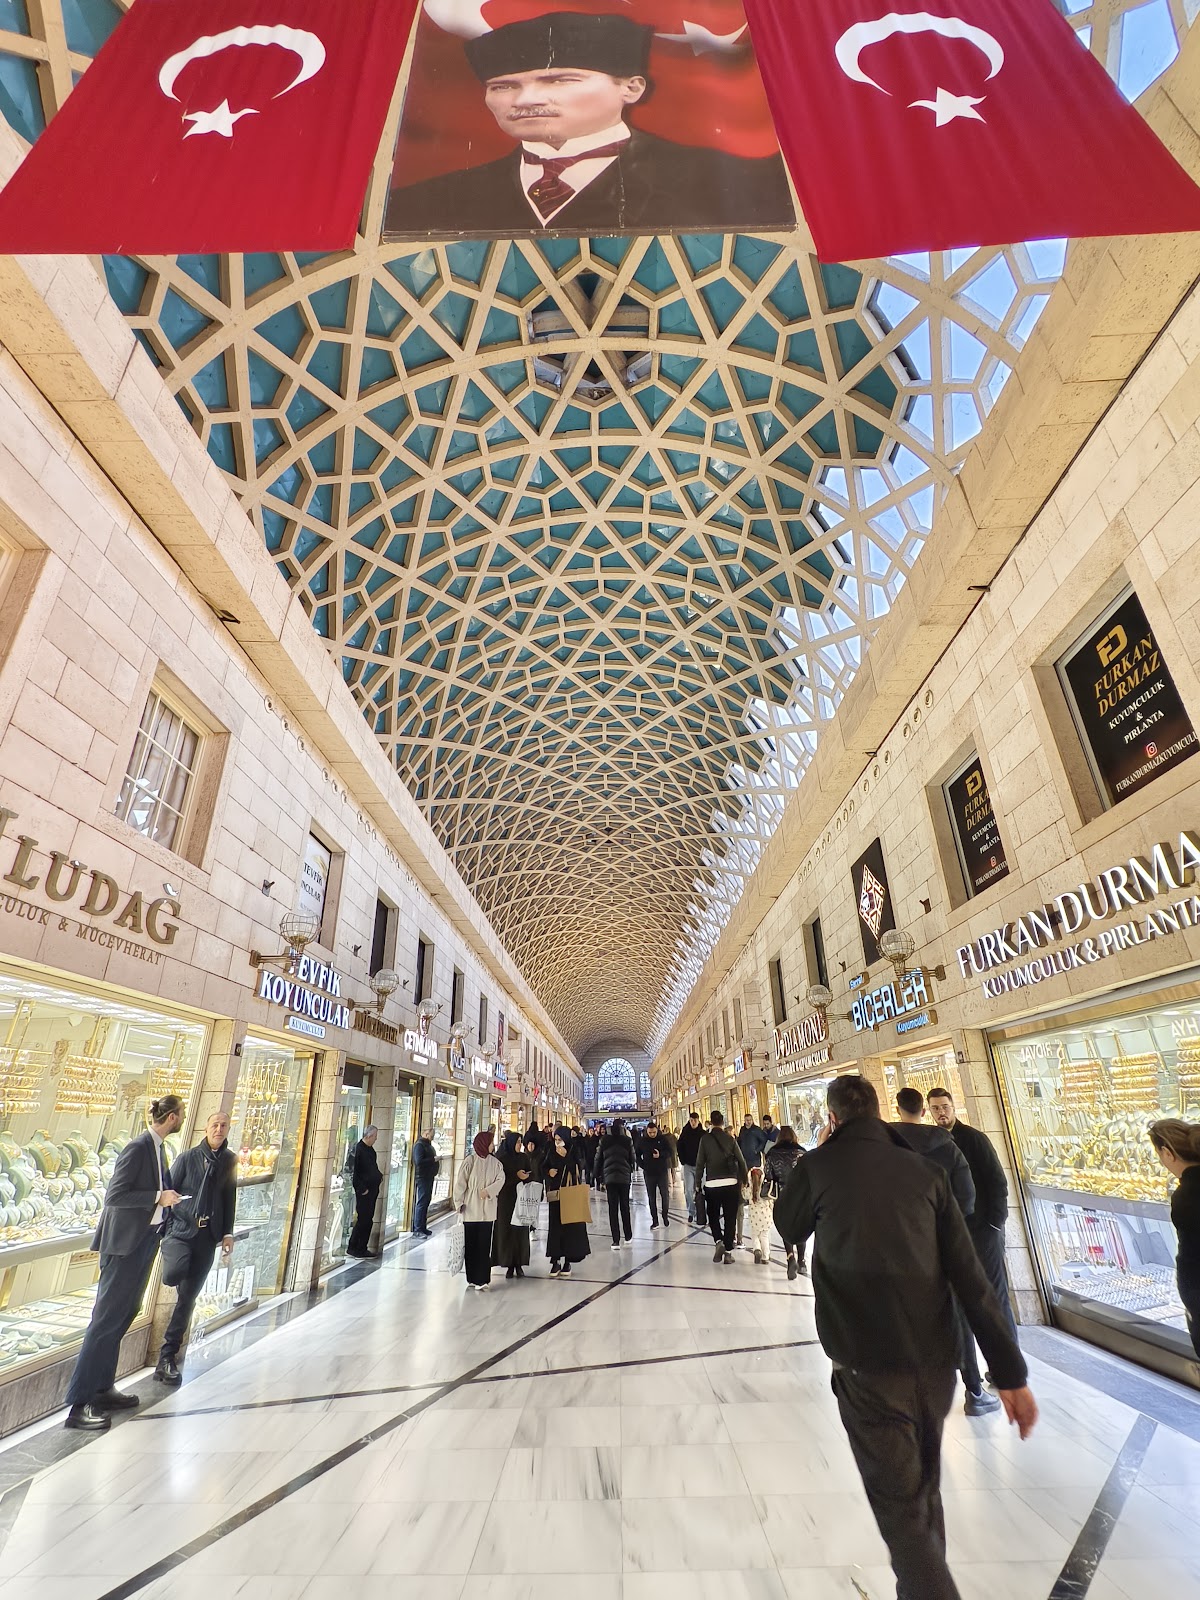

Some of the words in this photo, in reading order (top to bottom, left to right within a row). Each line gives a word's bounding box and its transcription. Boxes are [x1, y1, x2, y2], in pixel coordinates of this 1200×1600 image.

[1094, 633, 1154, 699] FURKAN
[1098, 650, 1161, 718] DURMAZ
[1109, 679, 1165, 730] KUYUMCULUK
[1123, 709, 1165, 744] PIRLANTA
[1135, 711, 1143, 722] &
[0, 894, 50, 926] ULUK
[58, 917, 69, 932] &
[75, 922, 162, 966] MÜCEVHERAT
[956, 904, 1055, 979] FURKAN
[981, 943, 1087, 999] KUYUMCULUK
[1087, 938, 1100, 963] &
[260, 970, 350, 1029] KOYUNCULAR
